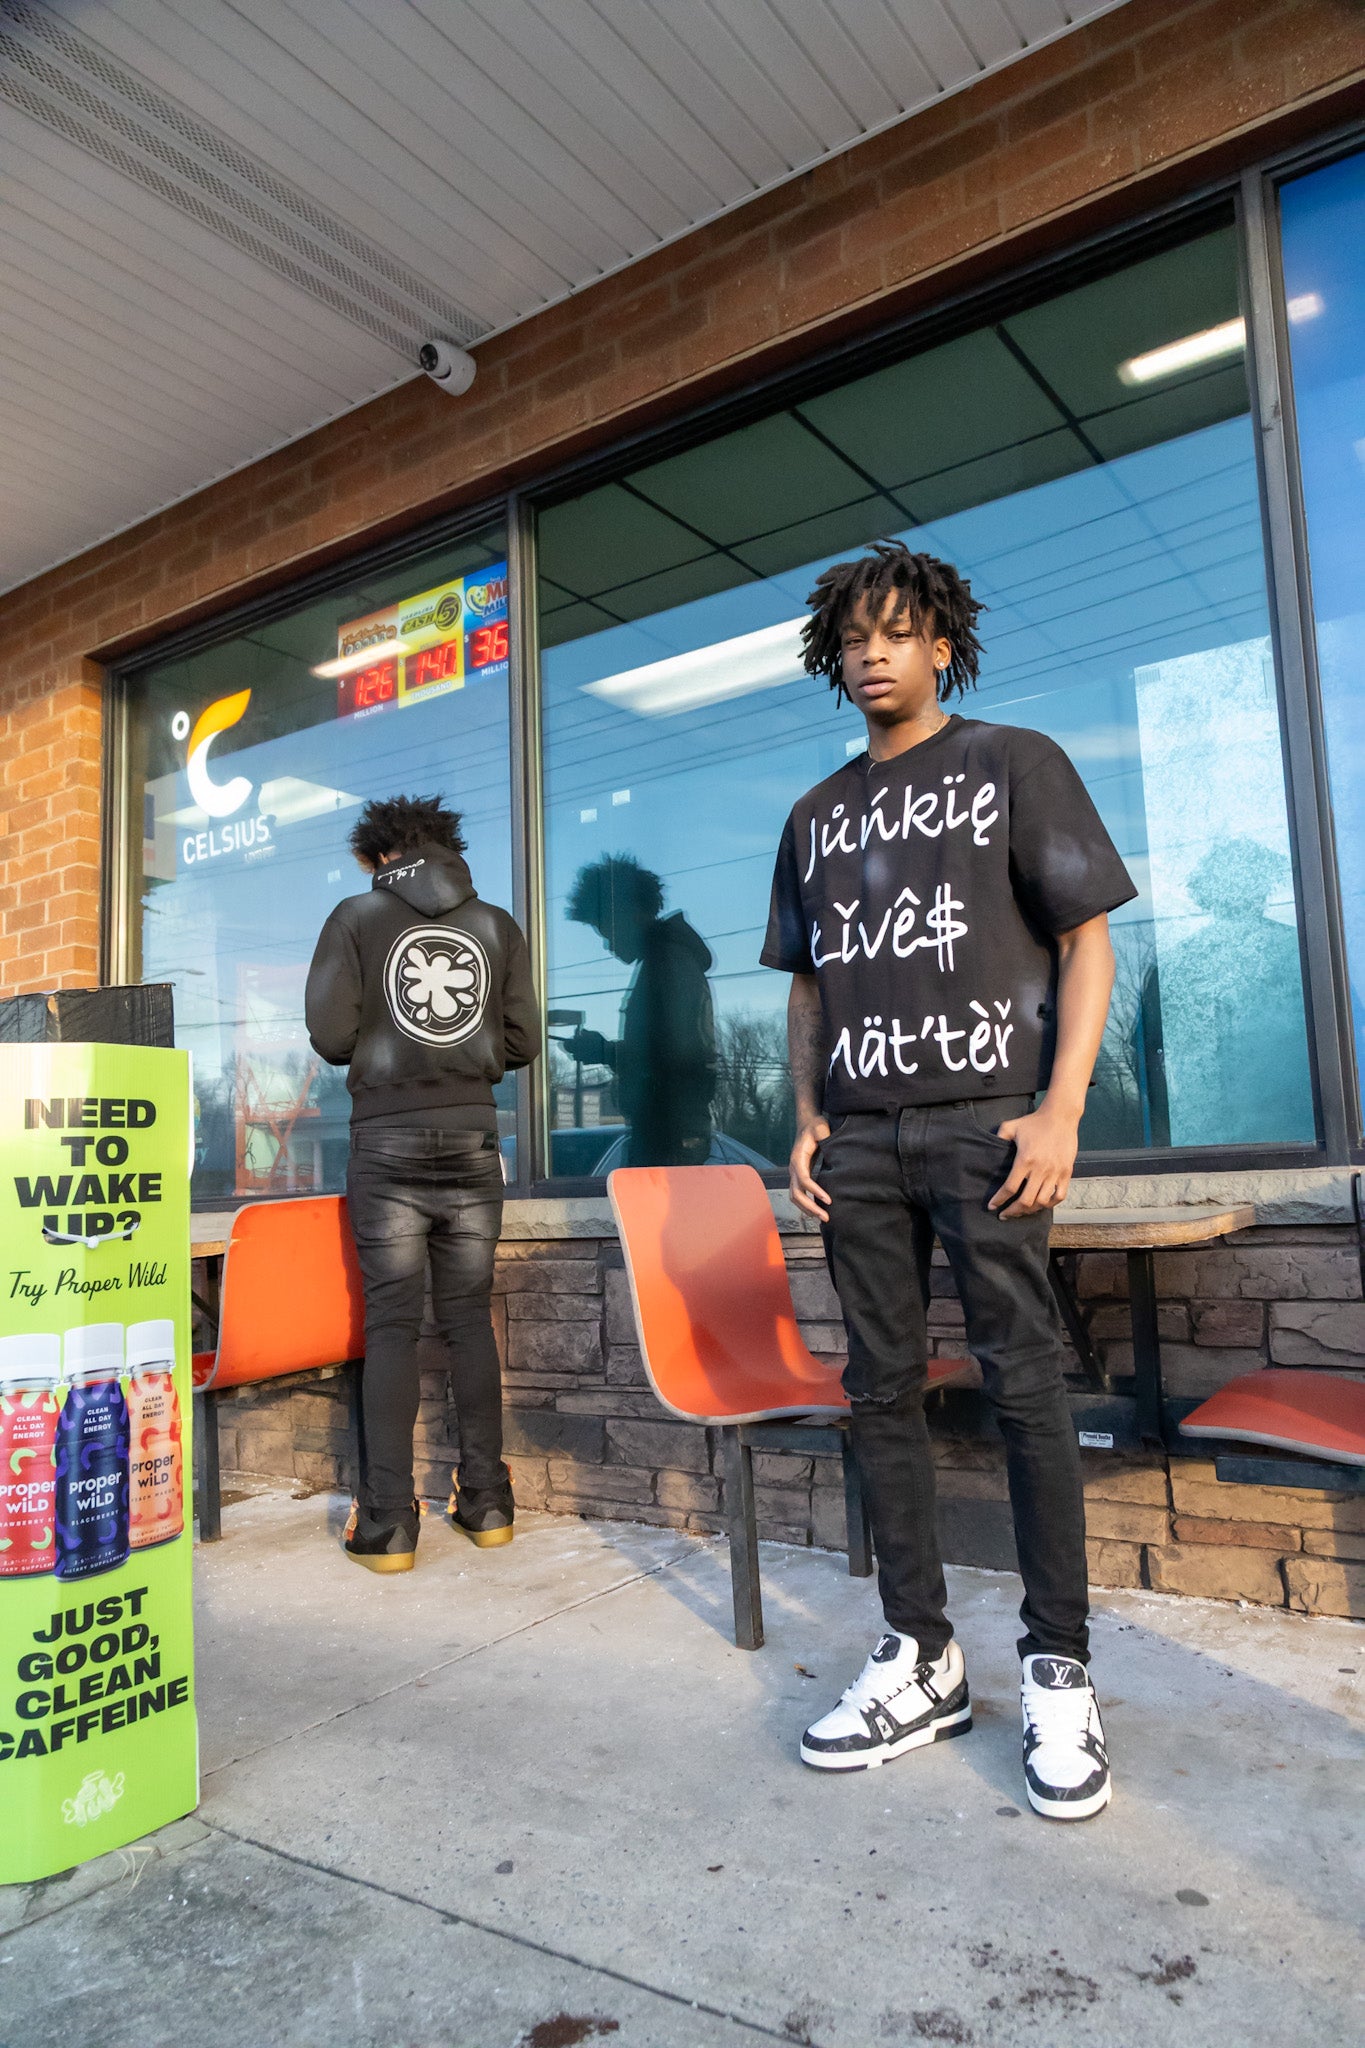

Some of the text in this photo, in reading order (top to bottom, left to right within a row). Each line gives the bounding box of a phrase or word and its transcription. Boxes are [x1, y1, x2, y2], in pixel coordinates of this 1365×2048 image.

[415, 641, 457, 685] 140
[355, 662, 394, 705] 126
[353, 703, 384, 720] MILLION
[182, 814, 271, 865] CELSIUS
[24, 1097, 157, 1130] NEED
[60, 1135, 130, 1167] TO
[13, 1172, 163, 1208] WAKE
[42, 1210, 142, 1246] UP?
[9, 1261, 168, 1306] Try Proper Wild
[16, 1415, 42, 1423] CLEAN
[29, 1422, 45, 1430] DAY
[83, 1414, 112, 1425] ALL DAY
[87, 1406, 109, 1416] CLEAN
[12, 1431, 45, 1440] ENERGY
[83, 1422, 112, 1434] ENERGY
[71, 1509, 119, 1527] BLACKBERRY
[32, 1586, 149, 1644] JUST
[17, 1623, 160, 1682] GOOD,
[15, 1651, 161, 1720] CLEAN
